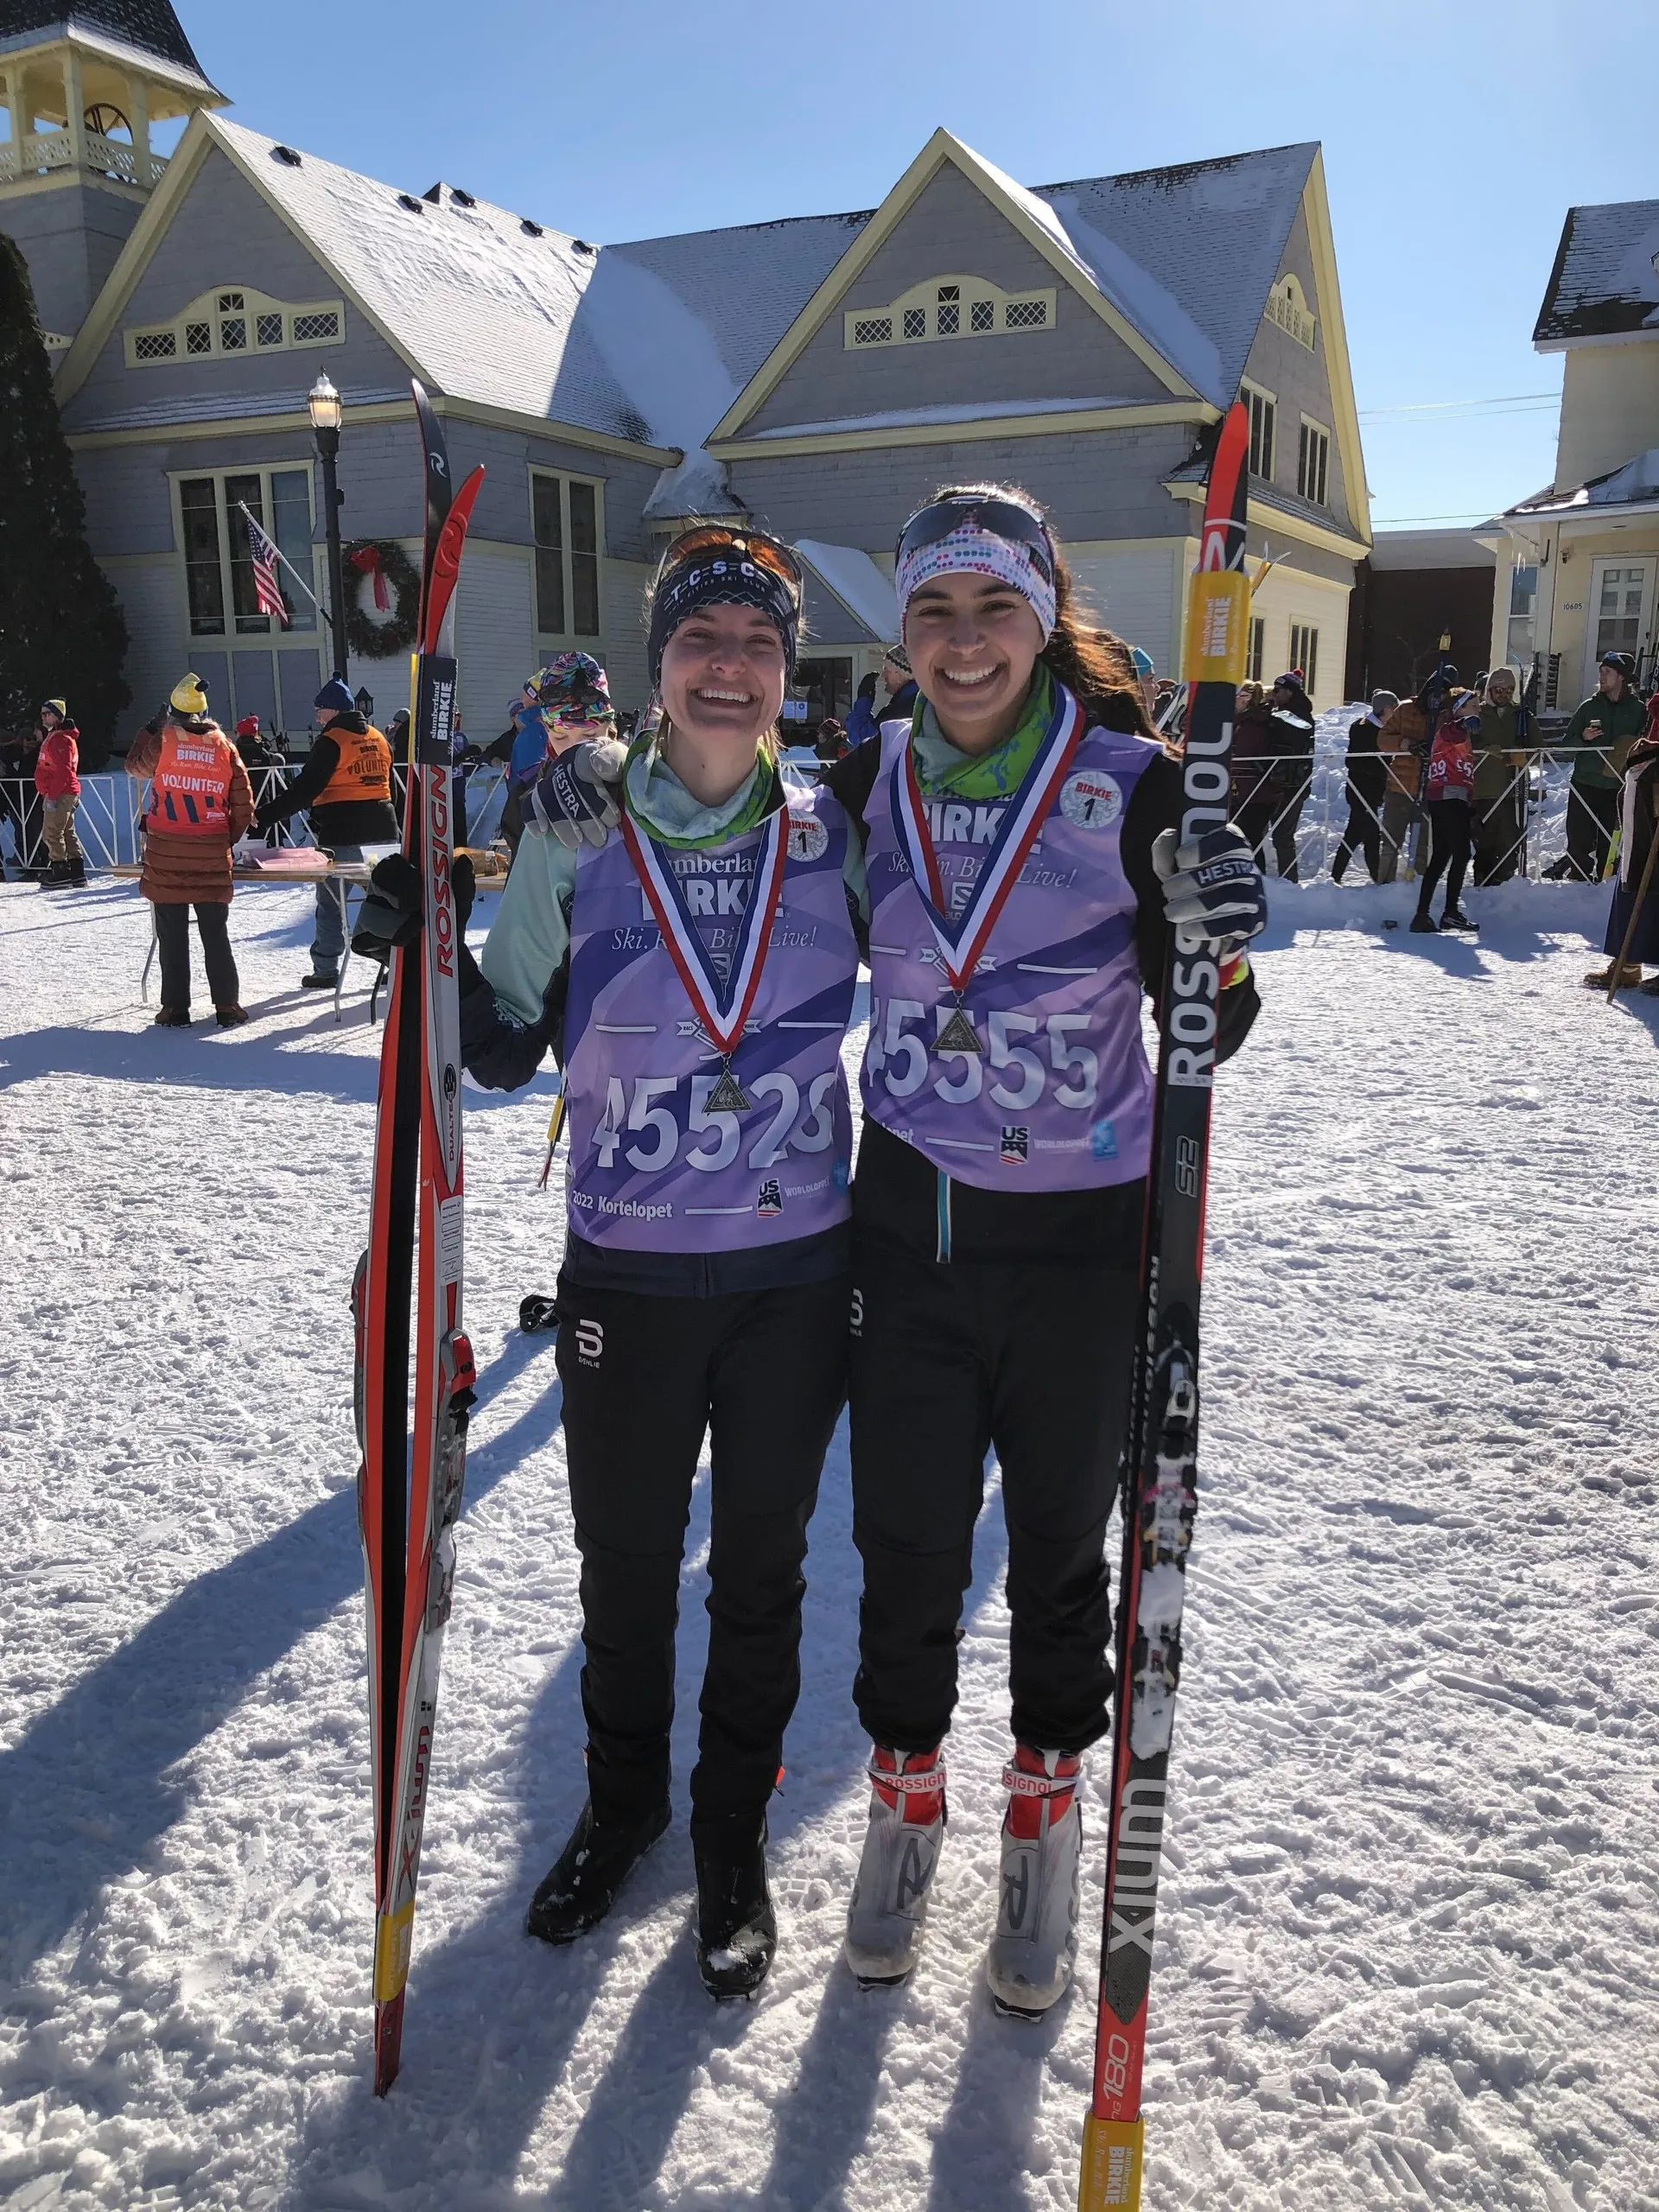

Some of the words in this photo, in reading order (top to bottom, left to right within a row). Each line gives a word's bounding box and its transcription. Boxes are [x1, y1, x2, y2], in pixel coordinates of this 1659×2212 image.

[1209, 596, 1231, 657] BIRKIE
[430, 681, 440, 739] slumberland
[436, 682, 452, 741] BIRKIE
[176, 749, 215, 765] BIRKIE
[162, 773, 225, 794] VOLUNTEER
[553, 763, 581, 818] HESTRA
[1075, 782, 1112, 801] BIRKIE
[1084, 798, 1096, 821] 1
[798, 831, 807, 853] 1
[1015, 862, 1077, 888] Live!
[612, 928, 648, 950] Ski.
[768, 925, 817, 947] Live!
[1001, 1126, 1028, 1141] US
[760, 1179, 779, 1197] US
[573, 1190, 594, 1210] 2022
[598, 1195, 673, 1222] Kortelopet
[1103, 2033, 1129, 2101] 180
[1104, 2145, 1125, 2206] BIRKIE
